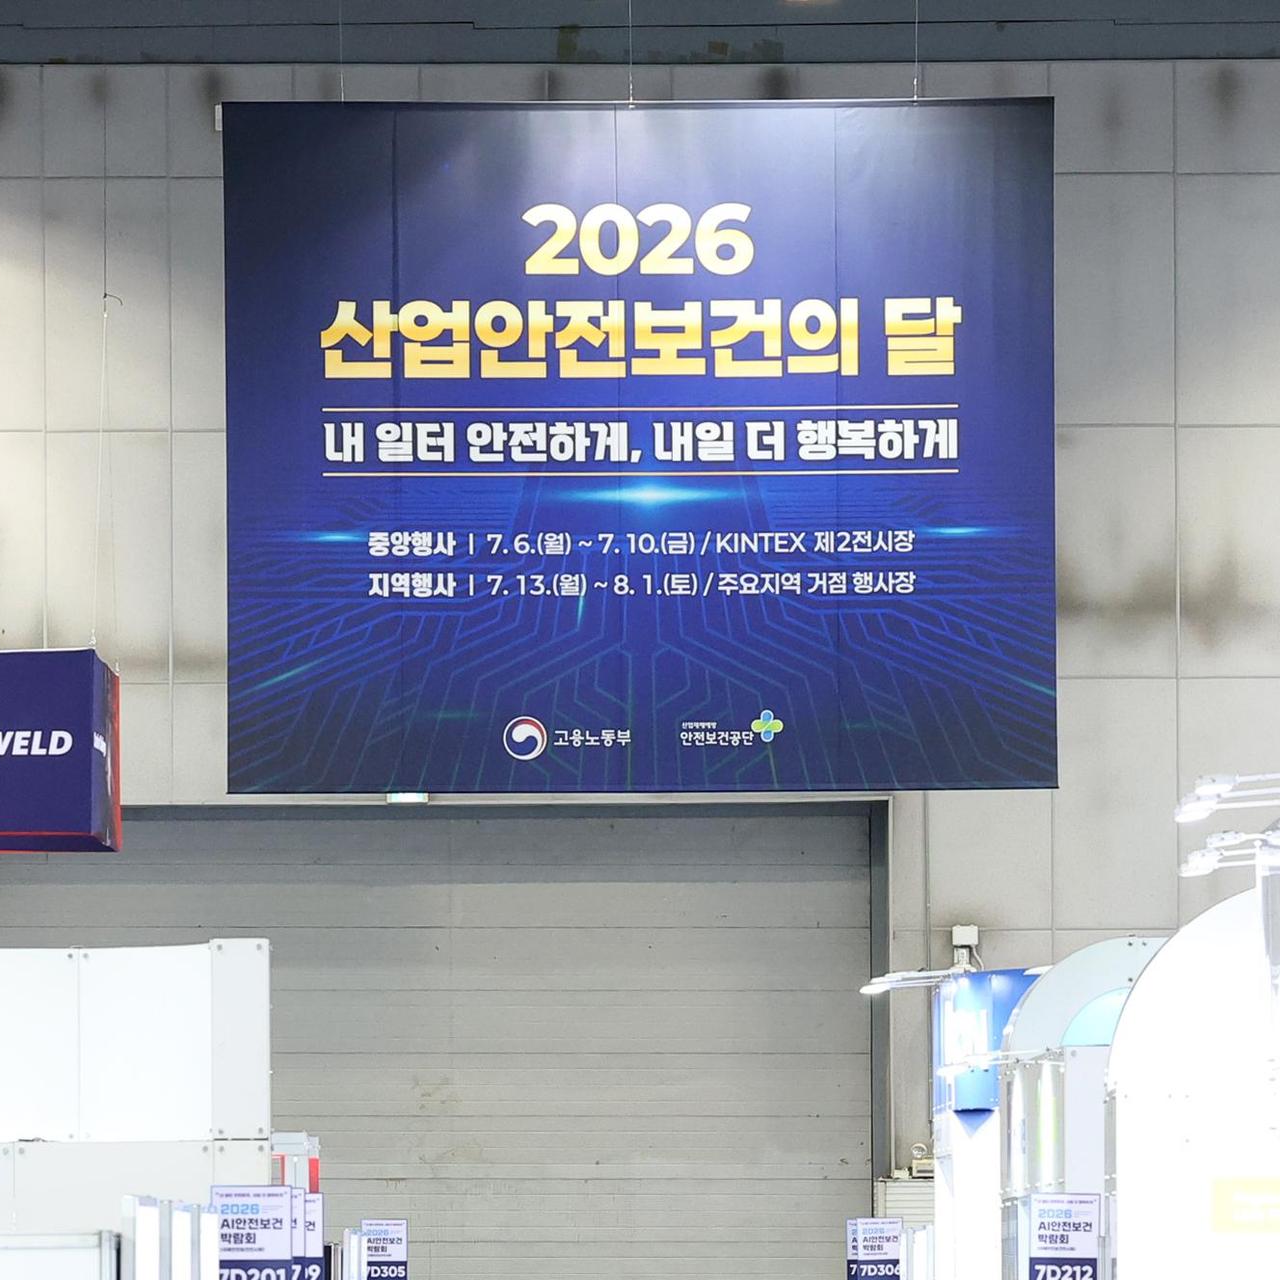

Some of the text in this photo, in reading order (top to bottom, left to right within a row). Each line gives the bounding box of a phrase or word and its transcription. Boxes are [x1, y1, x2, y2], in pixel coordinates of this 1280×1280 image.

[521, 201, 755, 276] 2026
[320, 296, 962, 379] 산업안전보건의 달
[323, 417, 959, 465] 내 일터 안전하게, 내일 더 행복하게
[367, 531, 456, 558] 중앙행사
[716, 533, 805, 554] KINTEX
[813, 529, 916, 556] 제2전시장
[367, 572, 456, 598] 지역행사
[717, 571, 801, 597] 주요지역
[806, 570, 848, 597] 거점
[851, 570, 916, 597] 행사장
[553, 729, 632, 747] 고용노동부
[680, 731, 754, 746] 안전보건공단
[220, 1203, 260, 1215] 2026
[220, 1218, 283, 1230] AI안전보건
